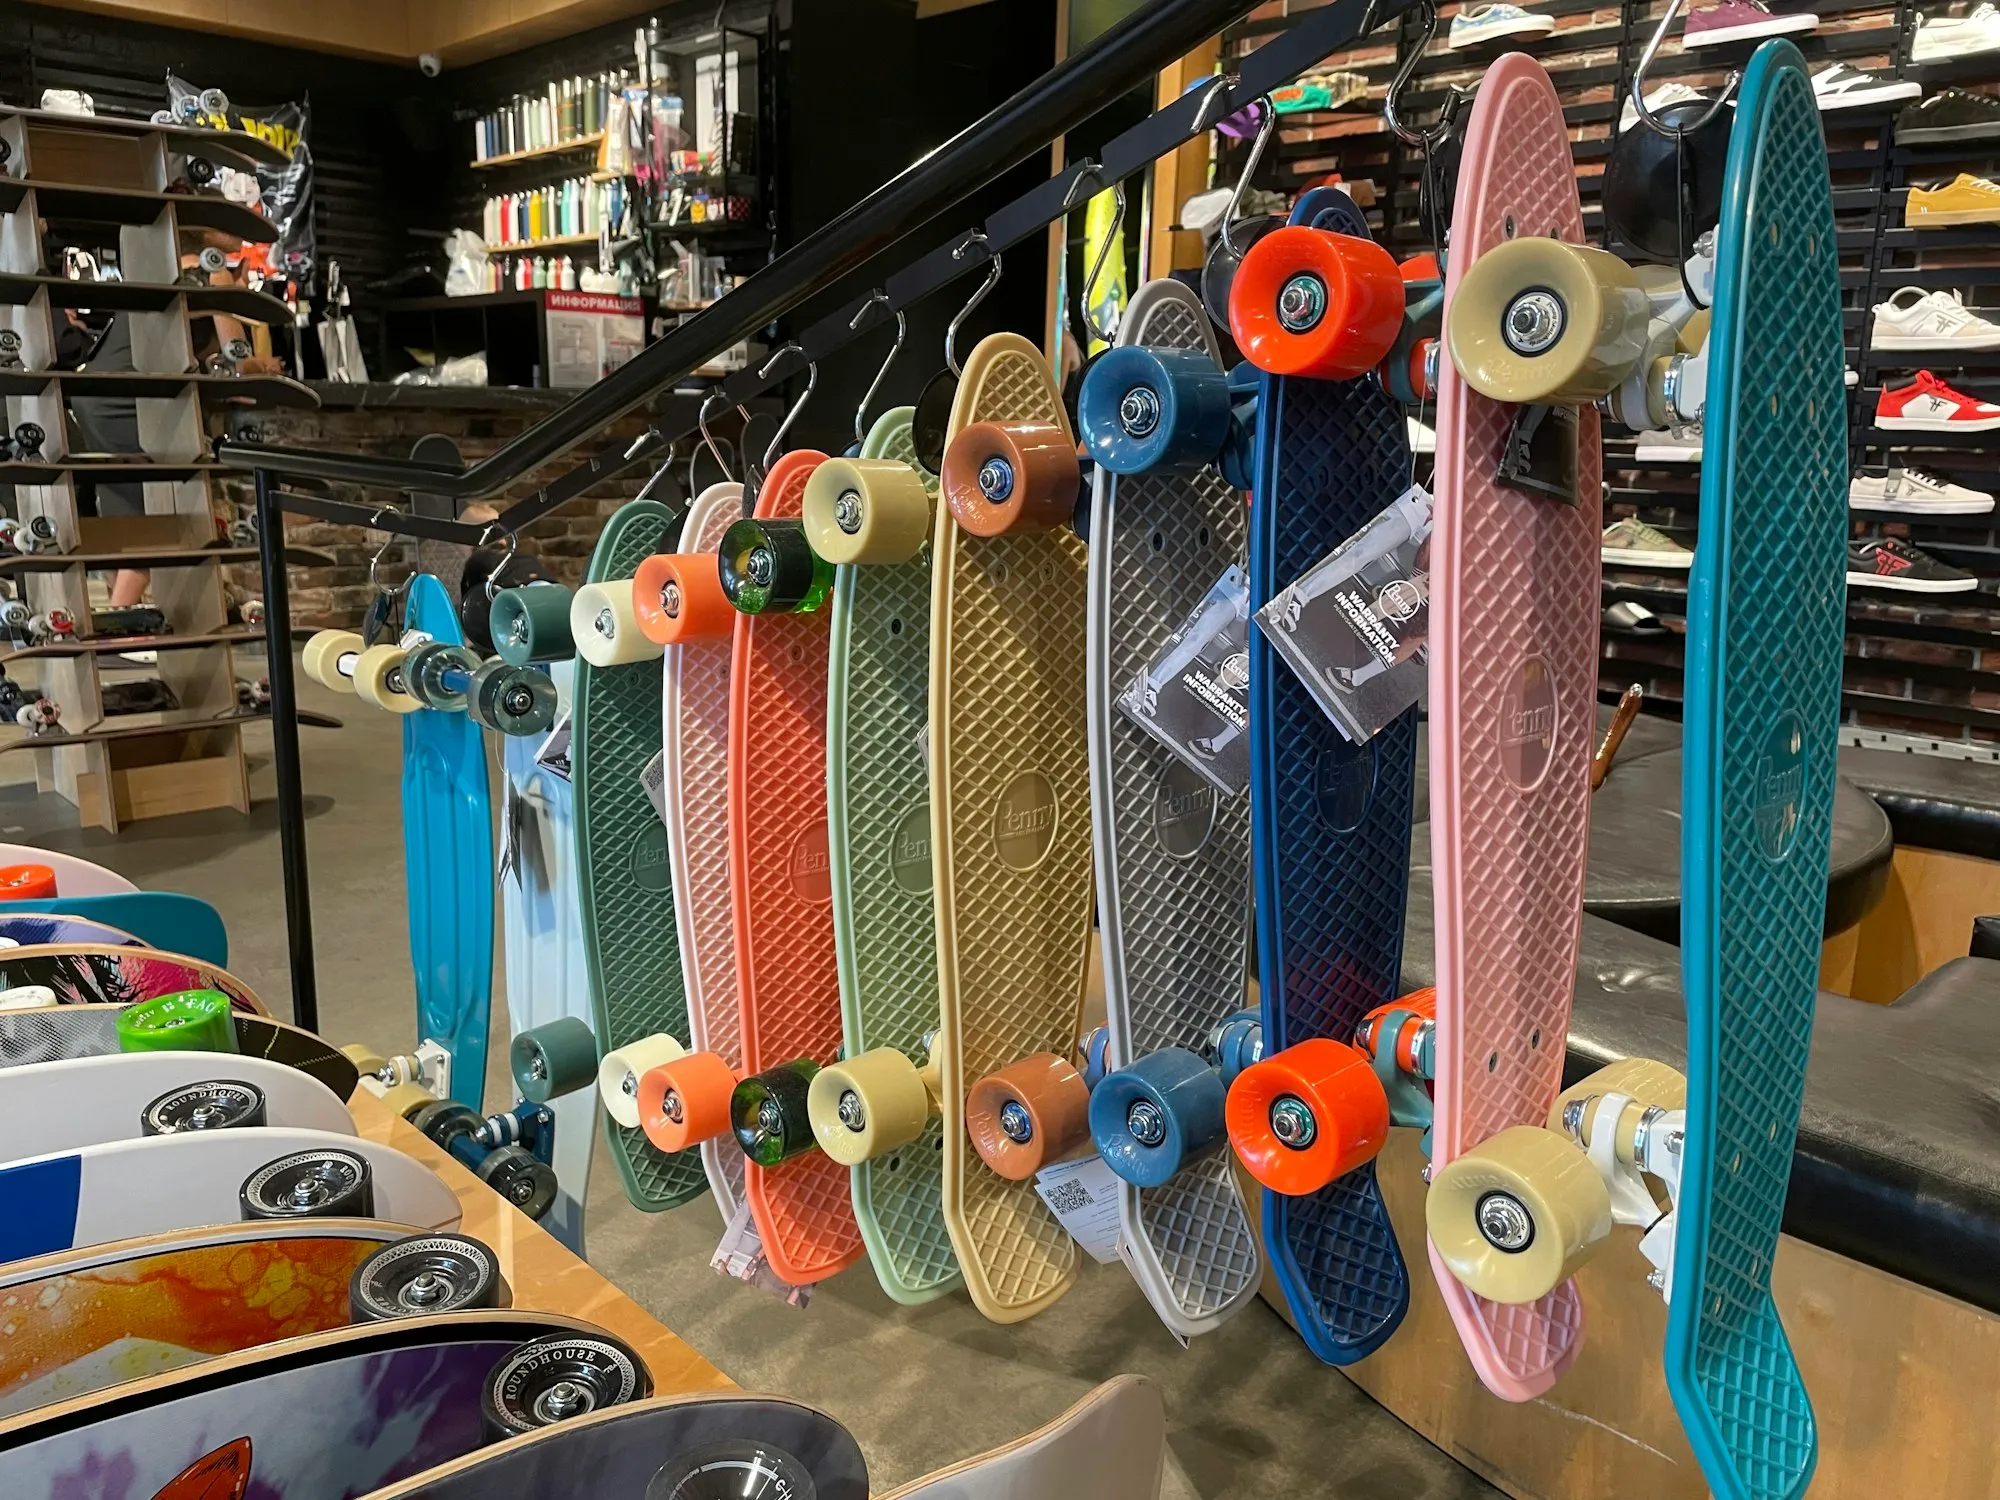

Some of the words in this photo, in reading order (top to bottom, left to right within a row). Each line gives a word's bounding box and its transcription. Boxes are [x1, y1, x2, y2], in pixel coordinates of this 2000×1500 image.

[551, 294, 641, 311] ИНФОРМАЦИЯ
[1385, 583, 1414, 614] Penny
[1335, 591, 1397, 663] INFORMATION
[1349, 590, 1400, 650] WARRANTY
[1182, 673, 1246, 727] INFORMATION
[1195, 670, 1247, 715] WARRANTY
[1503, 694, 1553, 742] Penny
[1000, 800, 1055, 838] Penny
[1160, 784, 1212, 825] Penny
[634, 842, 668, 871] Pen
[792, 842, 828, 874] Pen
[896, 830, 932, 865] Pen
[166, 1088, 246, 1112] ROUNDHOUSE
[506, 1348, 597, 1401] ROUNDHOUSE
